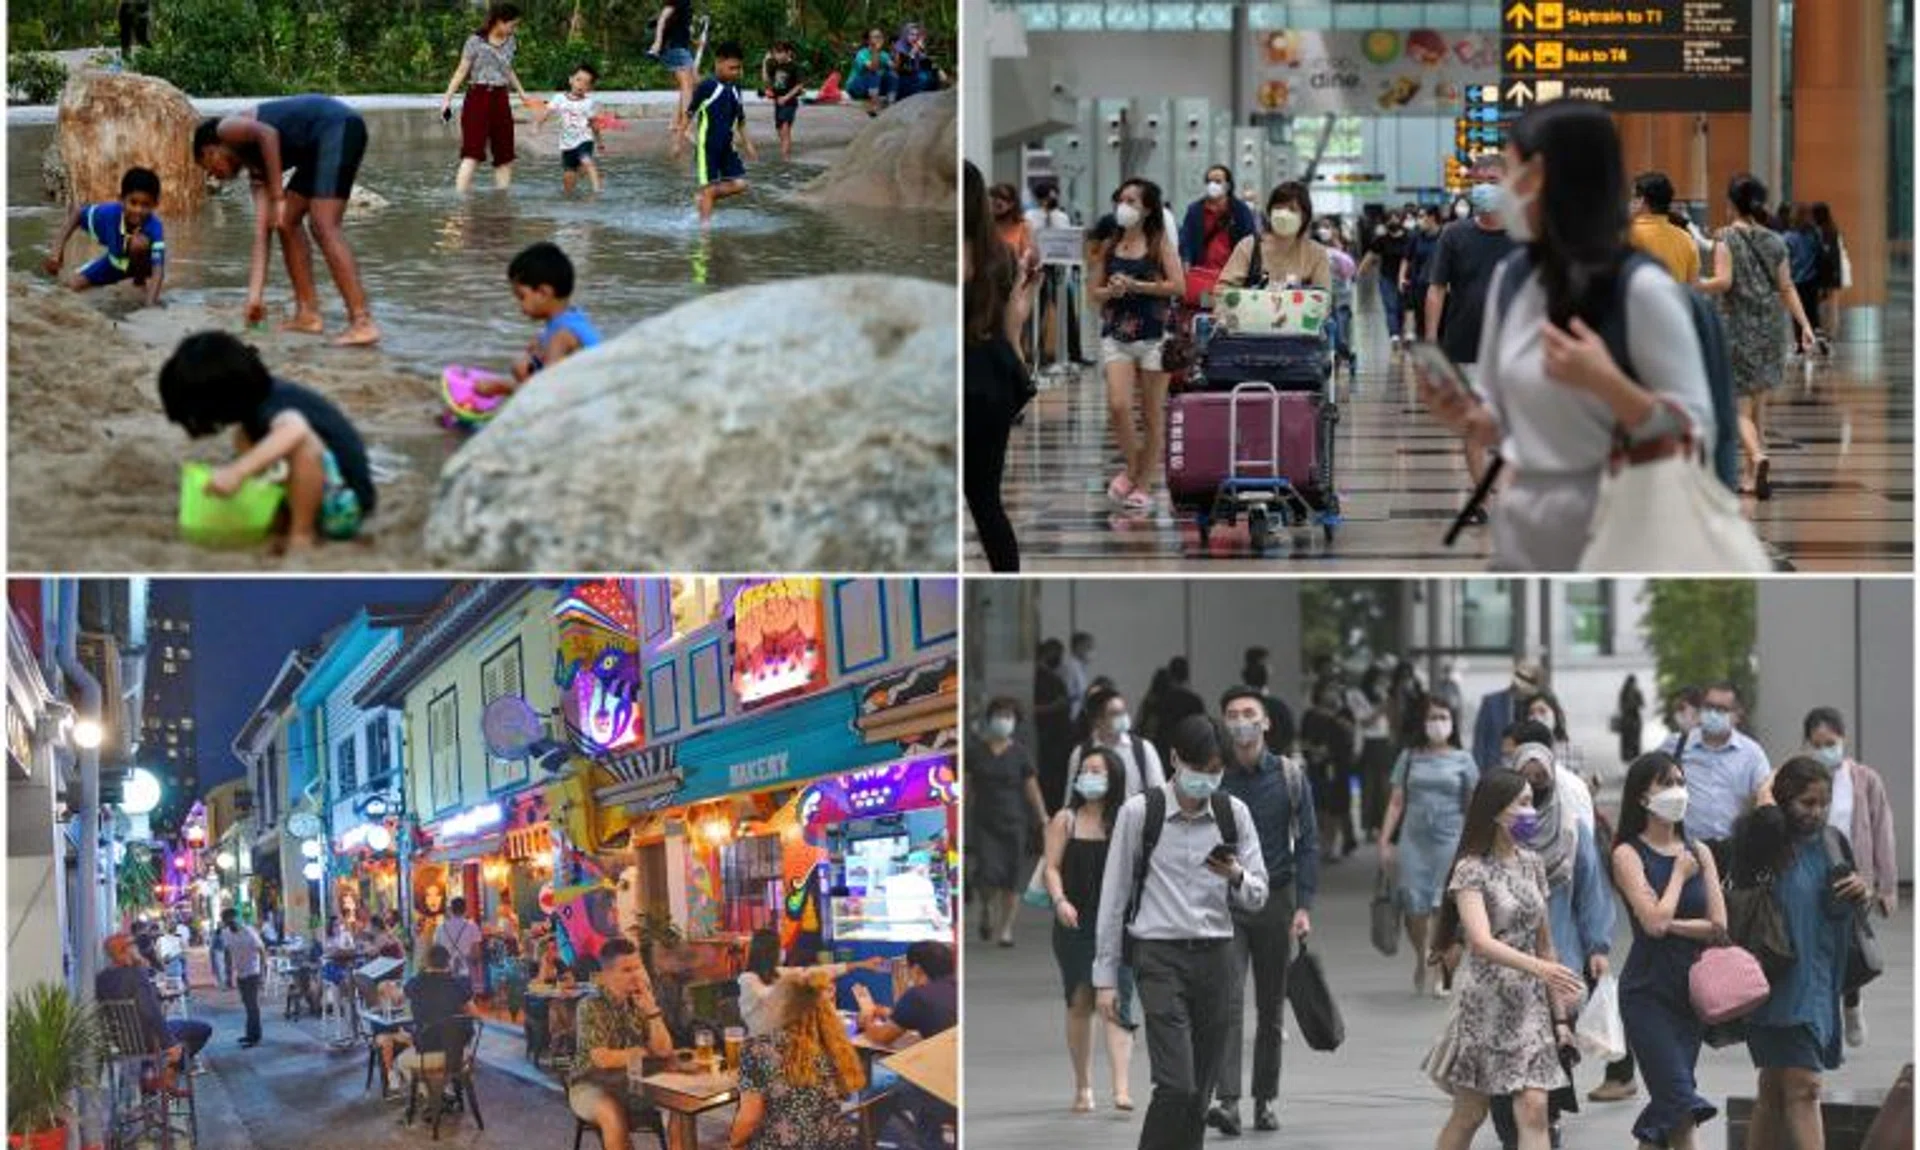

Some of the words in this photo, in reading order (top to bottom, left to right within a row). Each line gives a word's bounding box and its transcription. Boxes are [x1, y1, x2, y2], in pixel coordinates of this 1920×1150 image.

[1567, 9, 1624, 26] Skytrain
[1626, 10, 1642, 23] to
[1645, 9, 1662, 23] T1
[1566, 48, 1590, 62] Bus
[1592, 49, 1608, 62] to
[1609, 48, 1627, 62] T4
